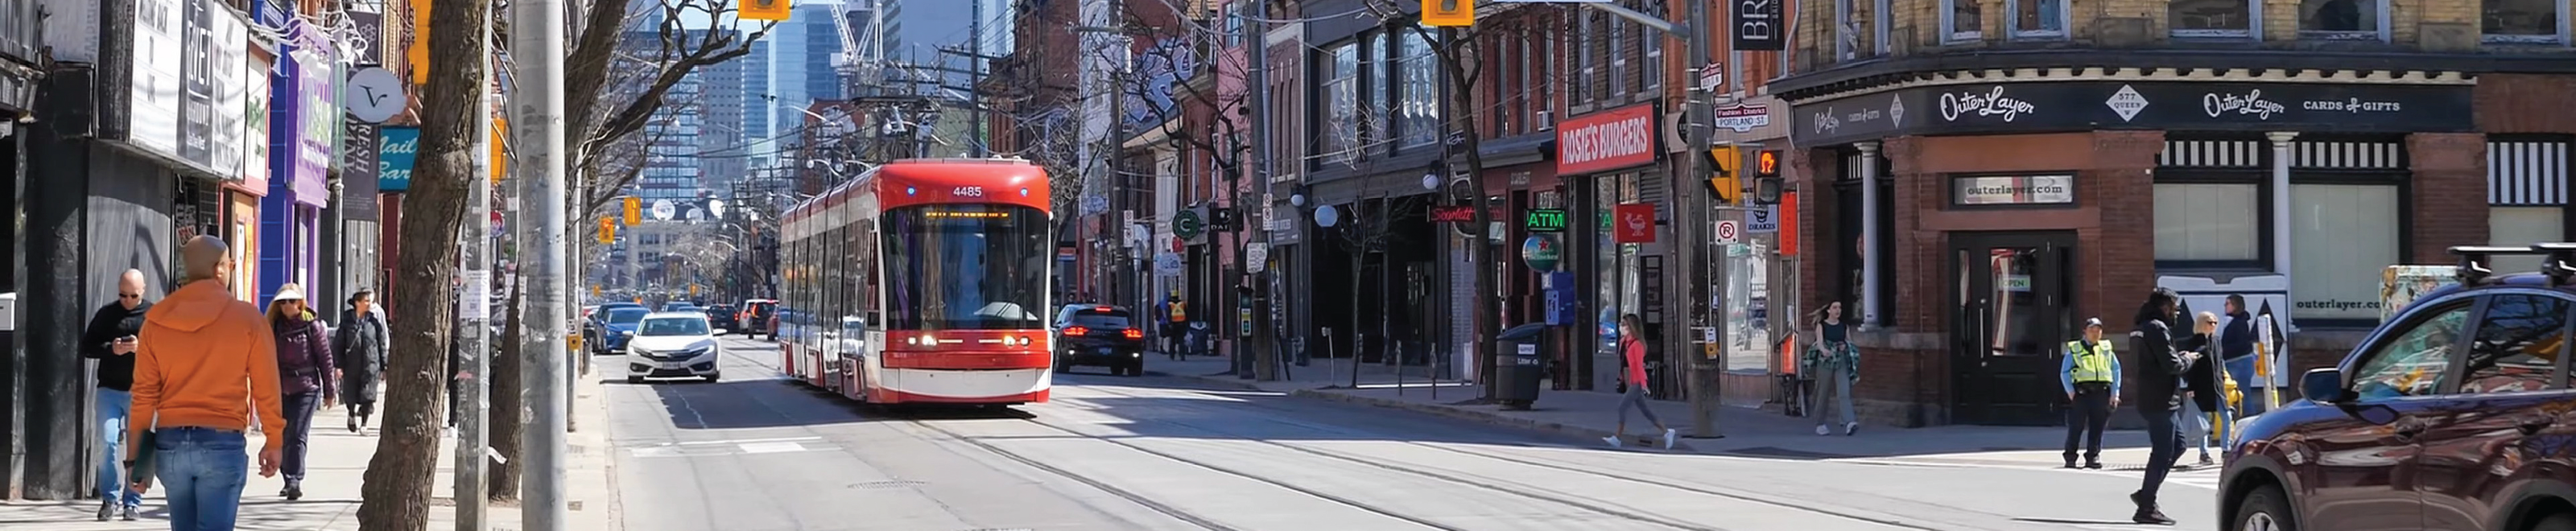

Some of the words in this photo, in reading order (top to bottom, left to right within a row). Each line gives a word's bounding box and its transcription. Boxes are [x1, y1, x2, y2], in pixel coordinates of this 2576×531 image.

[358, 84, 388, 108] V
[2119, 93, 2136, 101] 577
[1940, 93, 1986, 121] Outer
[1979, 85, 2035, 122] Layer
[2203, 93, 2246, 117] Outer
[2240, 88, 2285, 121] Layer
[2303, 101, 2343, 110] CARDS
[2363, 101, 2401, 111] GIFTS
[1719, 117, 1753, 126] PORTLAND
[1562, 122, 1599, 165] ROSIE'S
[1600, 116, 1648, 159] BURGERS
[356, 124, 372, 175] RESH
[953, 186, 982, 197] 4485
[1967, 185, 2062, 197] outerlayer.com
[1430, 207, 1476, 221] Scarlett
[1527, 212, 1563, 228] ATM
[1748, 223, 1776, 231] DRAKES
[2297, 298, 2381, 311] outerlayer.co
